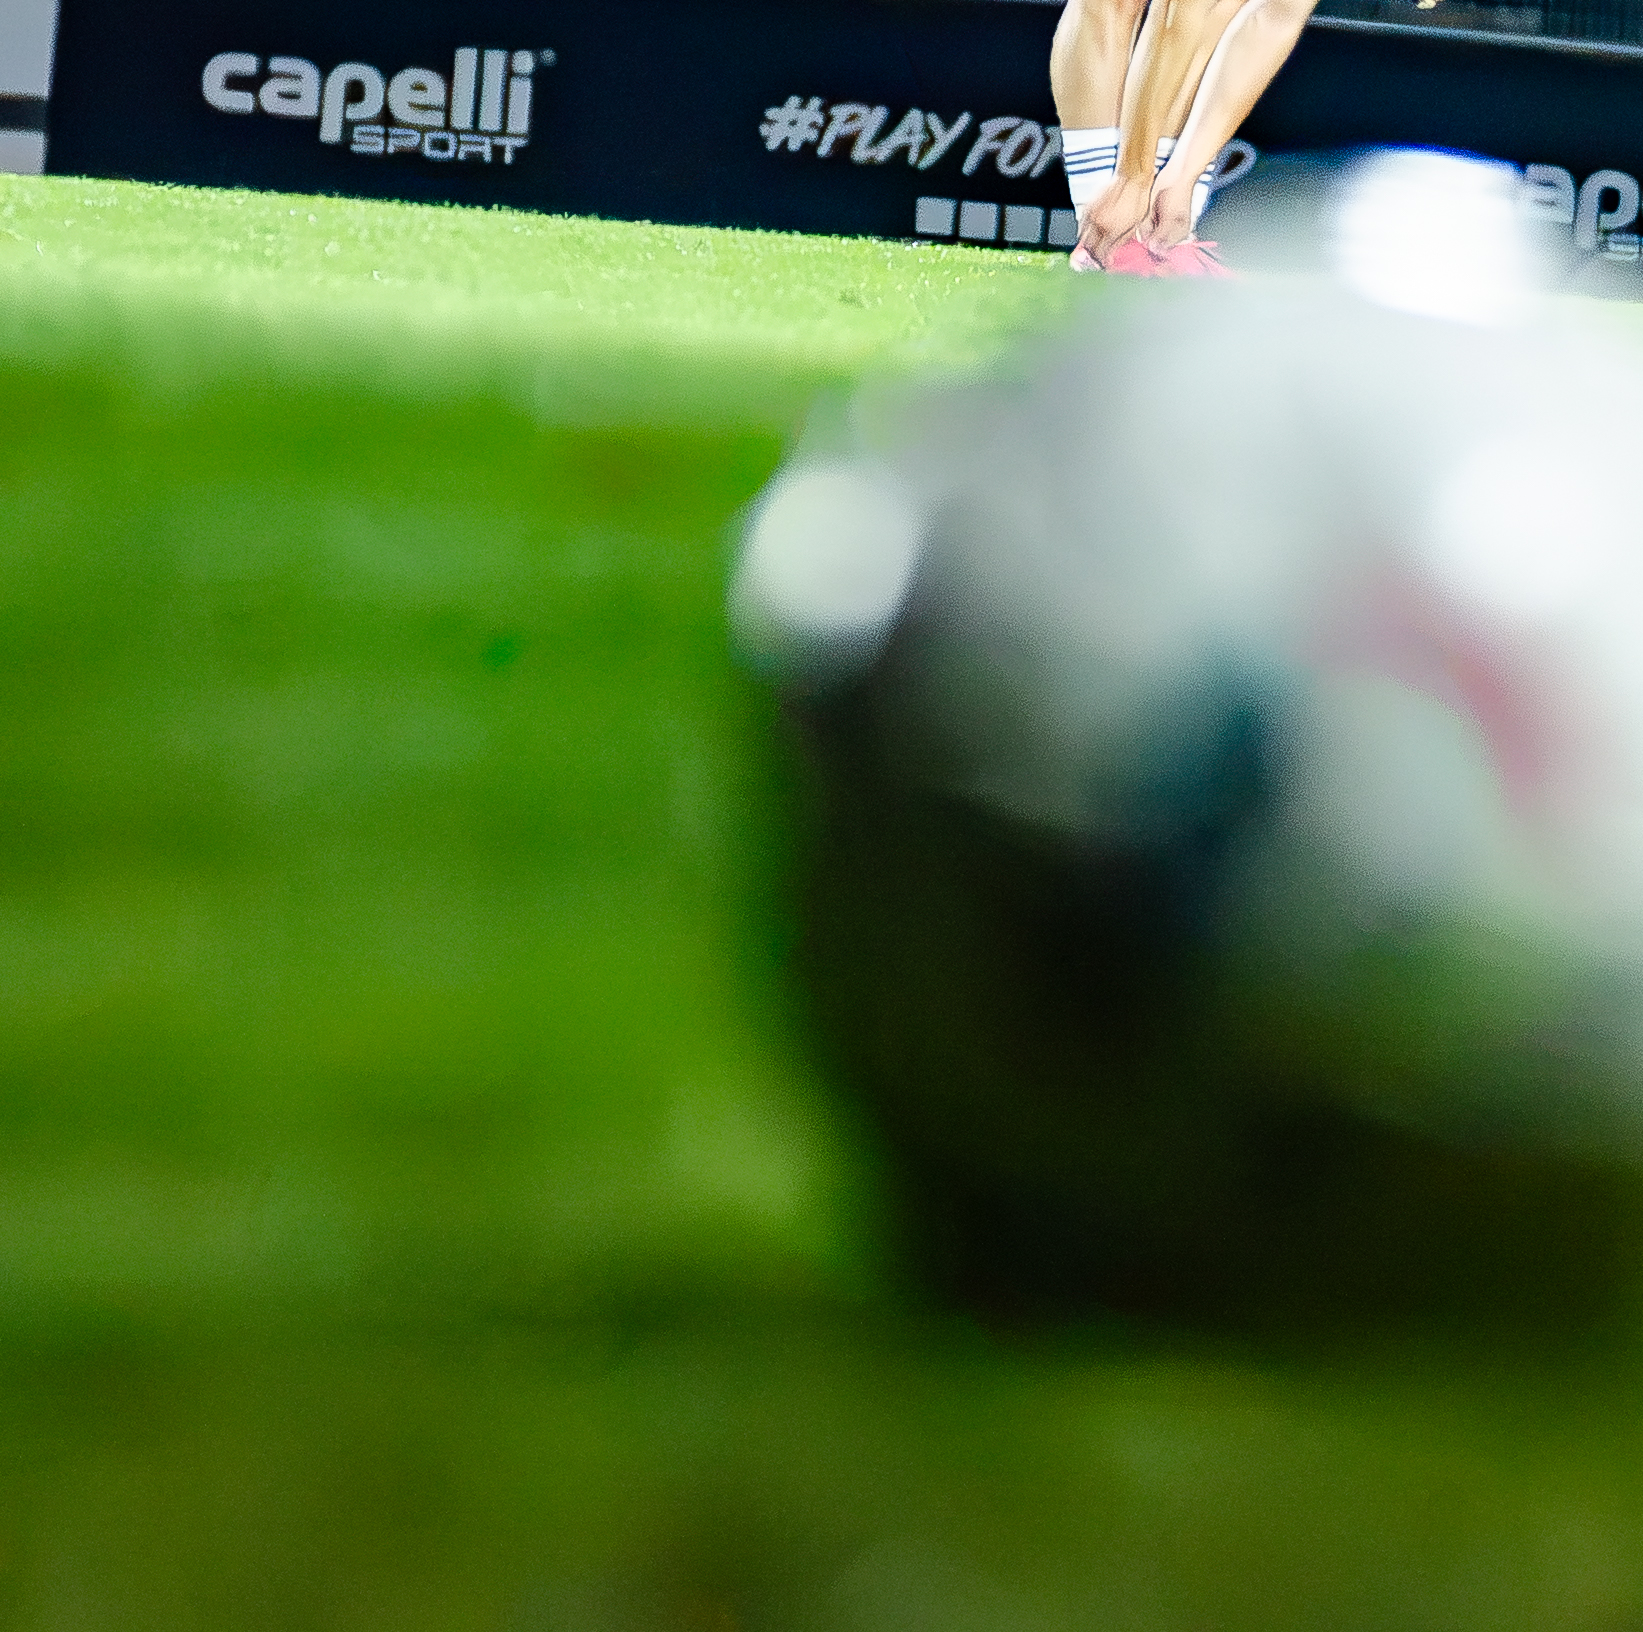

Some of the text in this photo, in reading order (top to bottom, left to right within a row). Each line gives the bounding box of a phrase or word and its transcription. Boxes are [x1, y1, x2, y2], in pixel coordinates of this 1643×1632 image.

[202, 46, 534, 144] capelli
[759, 94, 974, 171] #PLAY
[350, 124, 529, 165] SPORT
